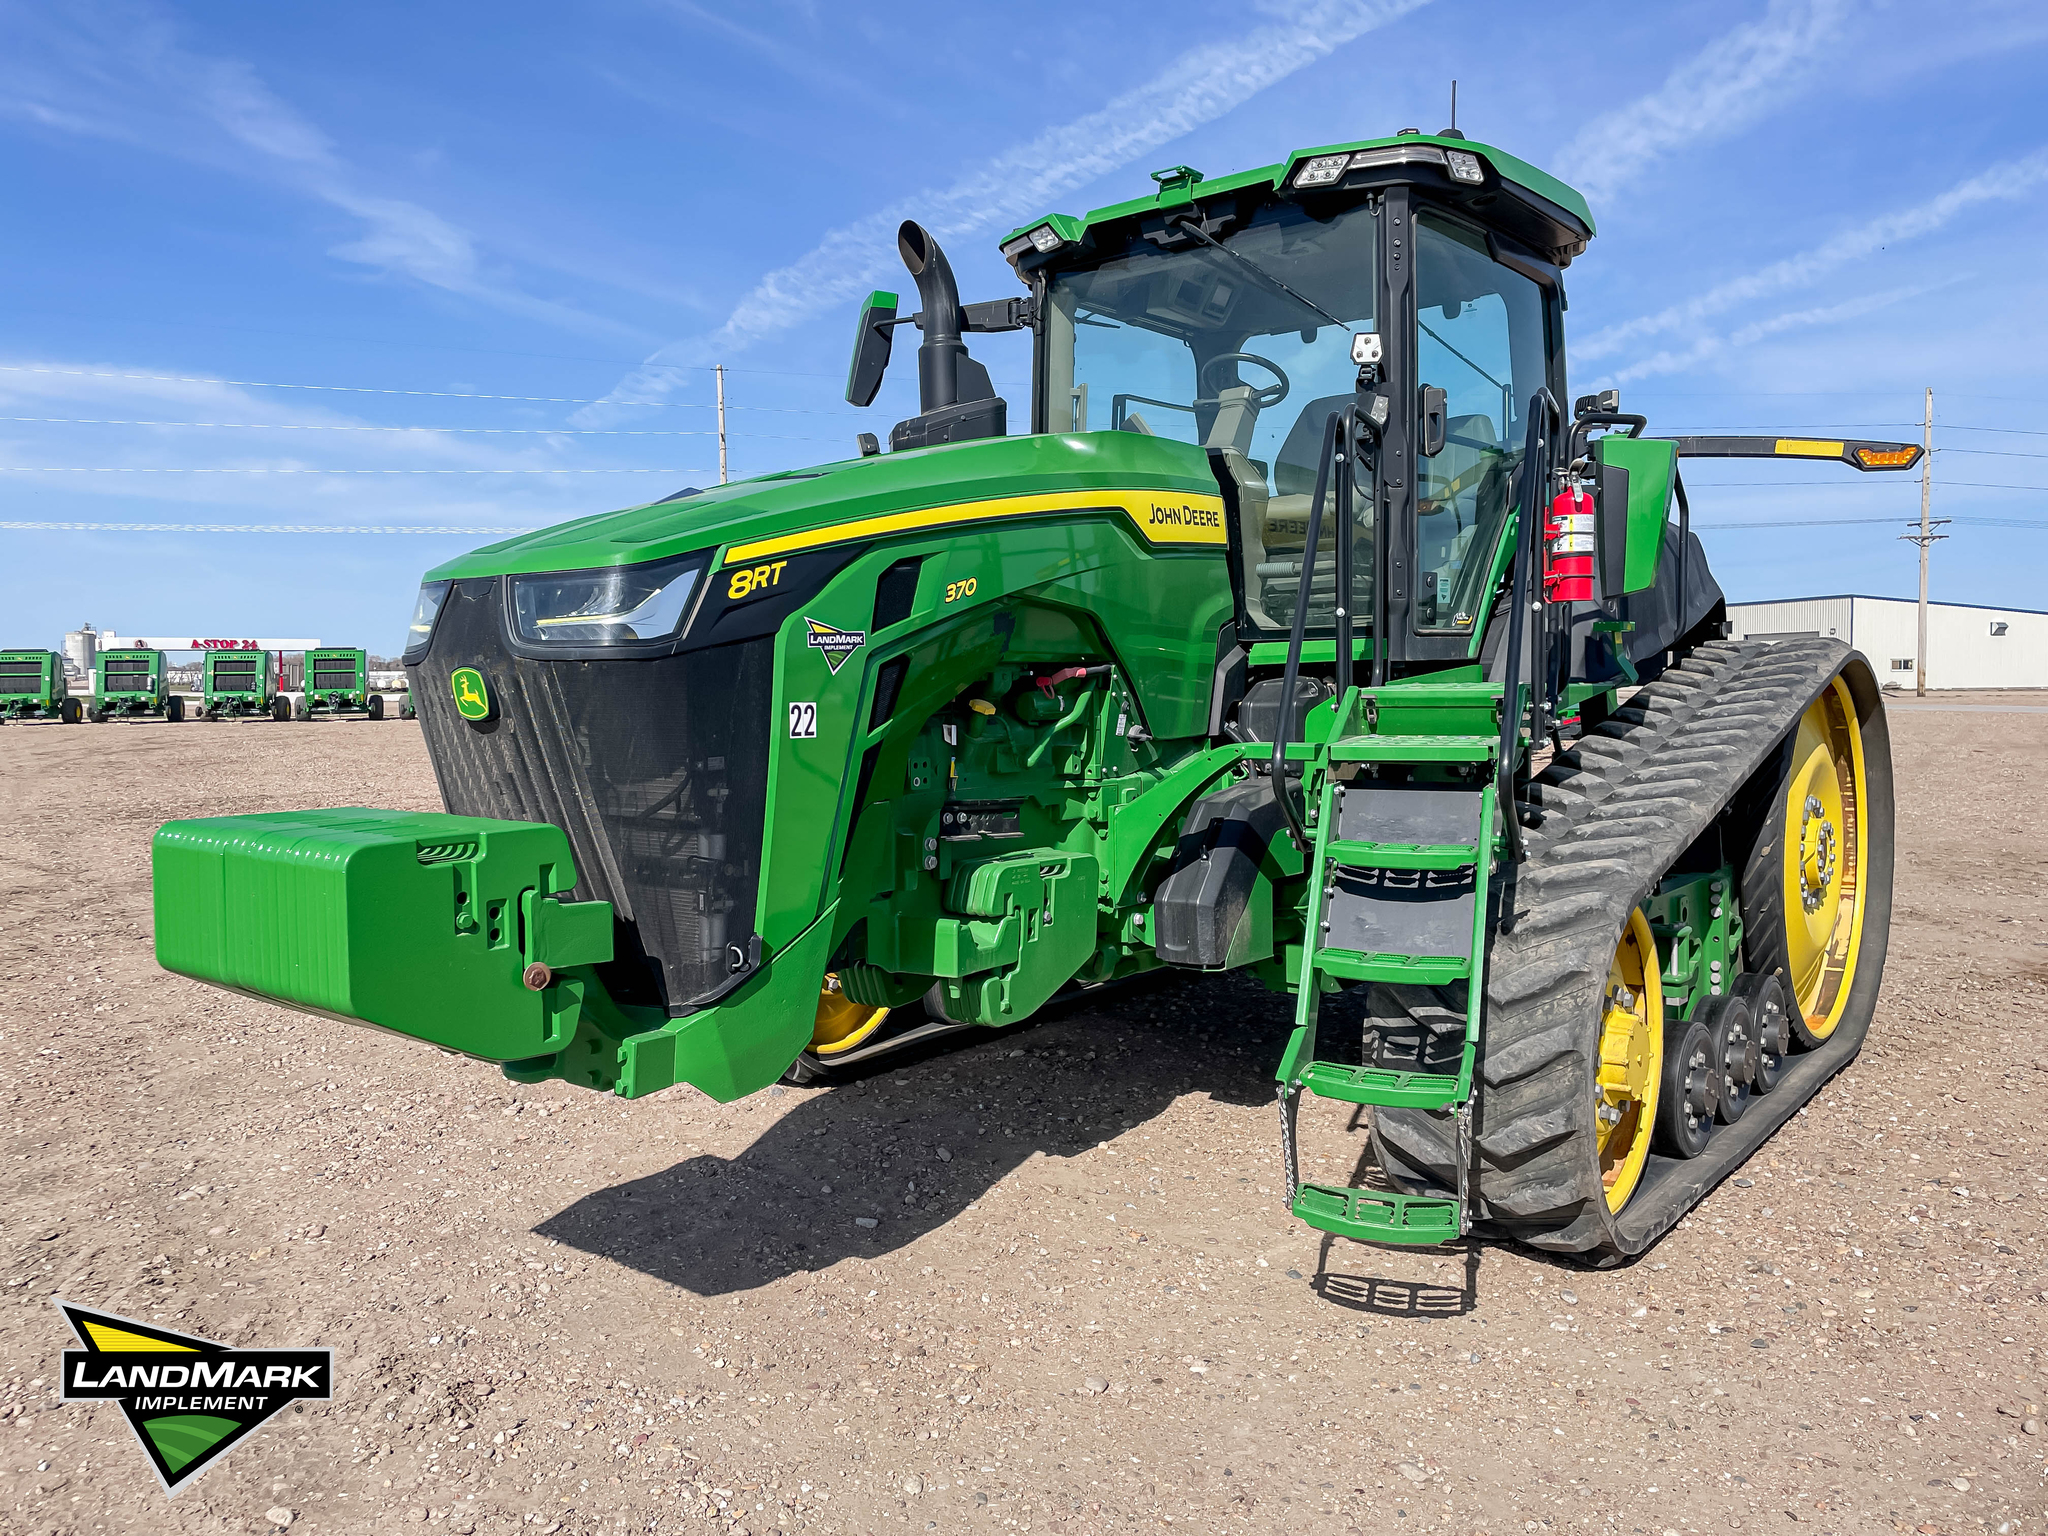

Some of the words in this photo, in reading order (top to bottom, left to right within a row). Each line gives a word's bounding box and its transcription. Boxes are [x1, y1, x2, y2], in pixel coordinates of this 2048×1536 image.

[1149, 503, 1182, 525] JOHN
[1182, 505, 1220, 527] DEERE
[728, 560, 788, 600] 8RT
[945, 577, 977, 603] 370
[191, 639, 238, 649] A-STOP
[242, 639, 258, 650] 24
[791, 704, 815, 737] 22
